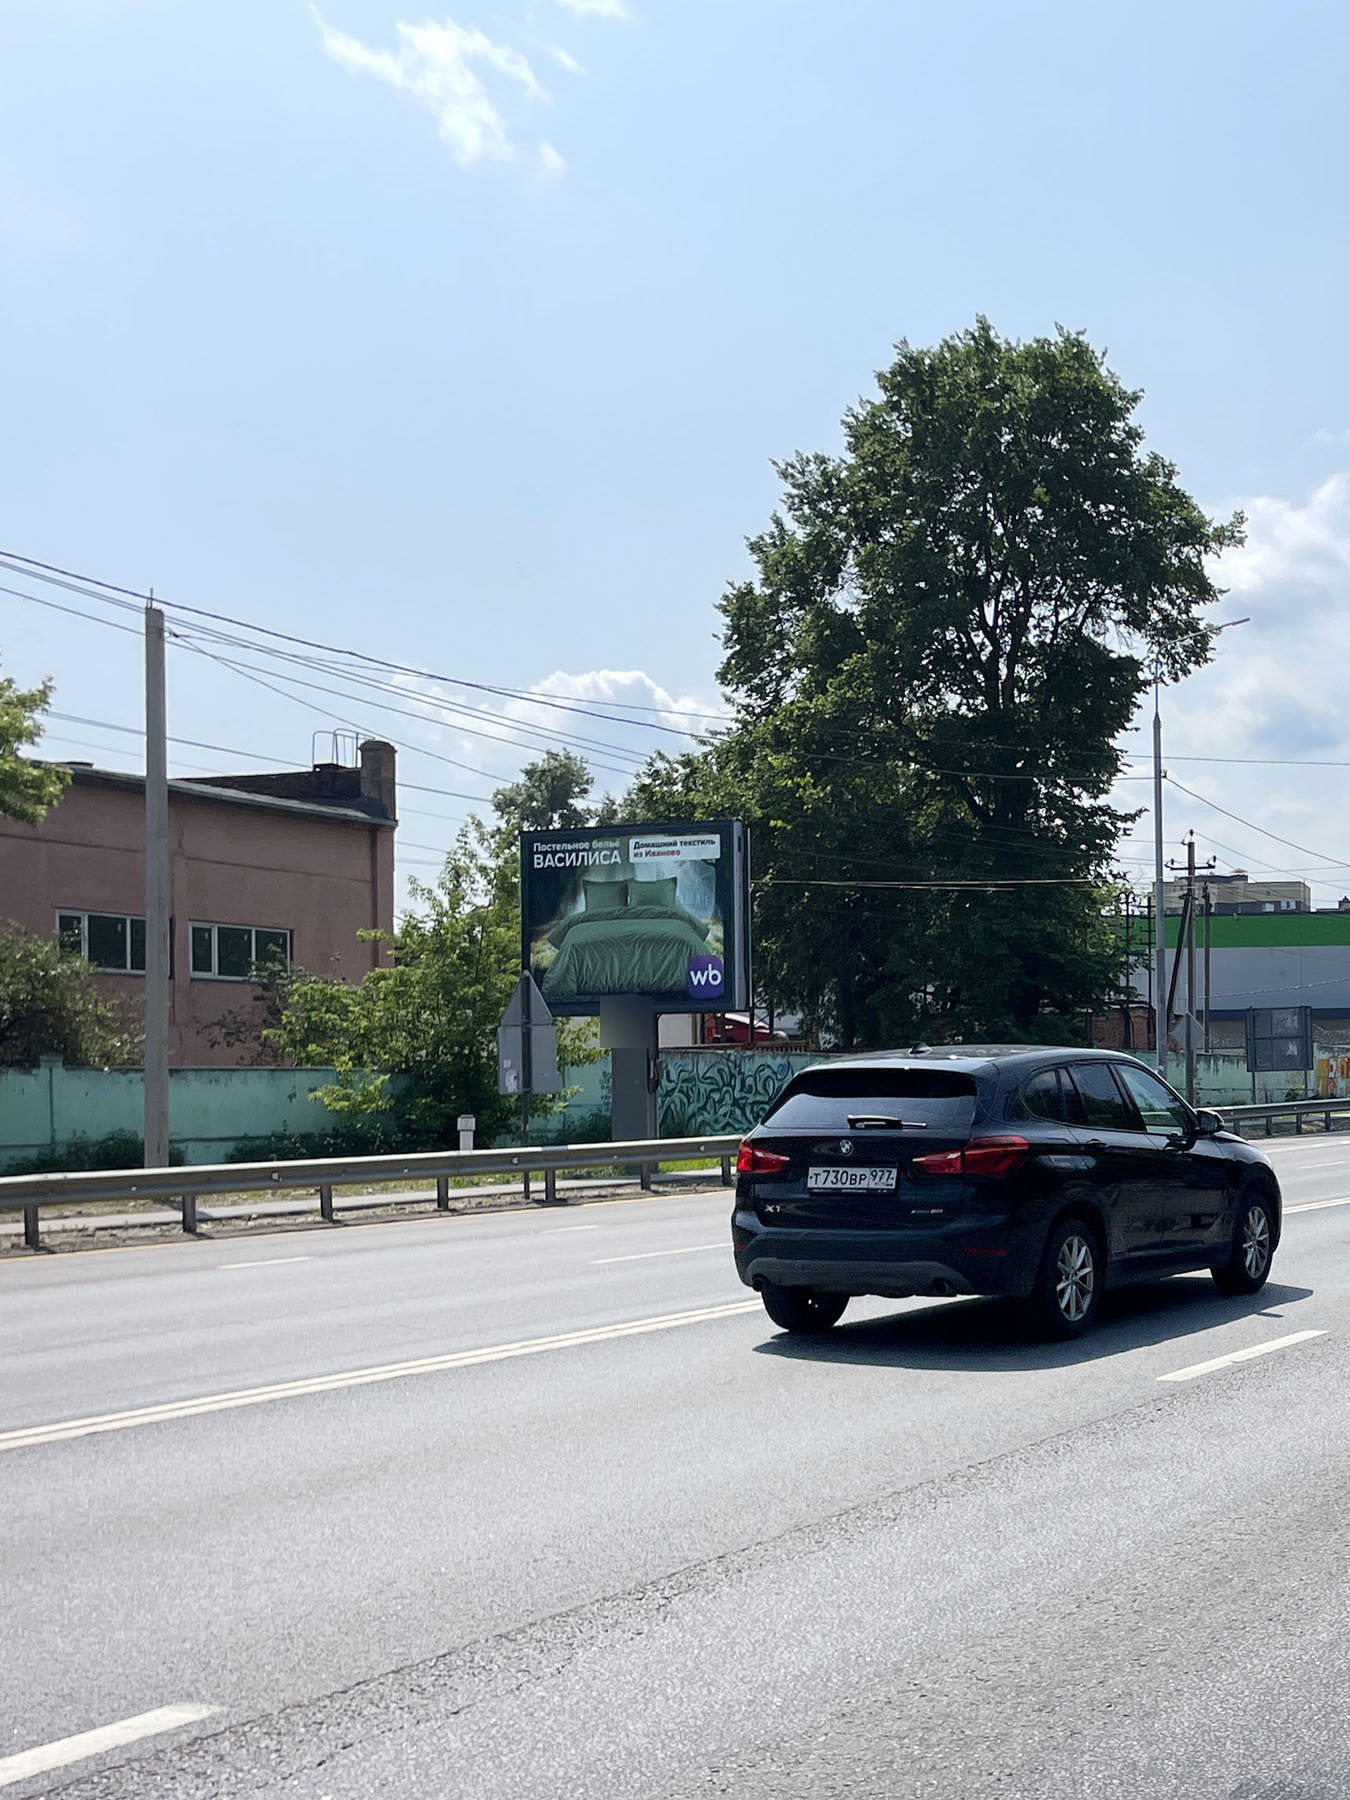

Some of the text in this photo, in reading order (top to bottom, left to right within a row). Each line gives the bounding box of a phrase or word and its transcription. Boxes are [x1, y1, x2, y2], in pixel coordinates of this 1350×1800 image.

[533, 841, 590, 852] Постельное
[633, 839, 716, 850] Домашний текстиль
[644, 849, 681, 858] Иваново
[533, 850, 622, 869] ВАСИЛИСА
[690, 964, 722, 987] wb
[765, 1204, 781, 1213] X1
